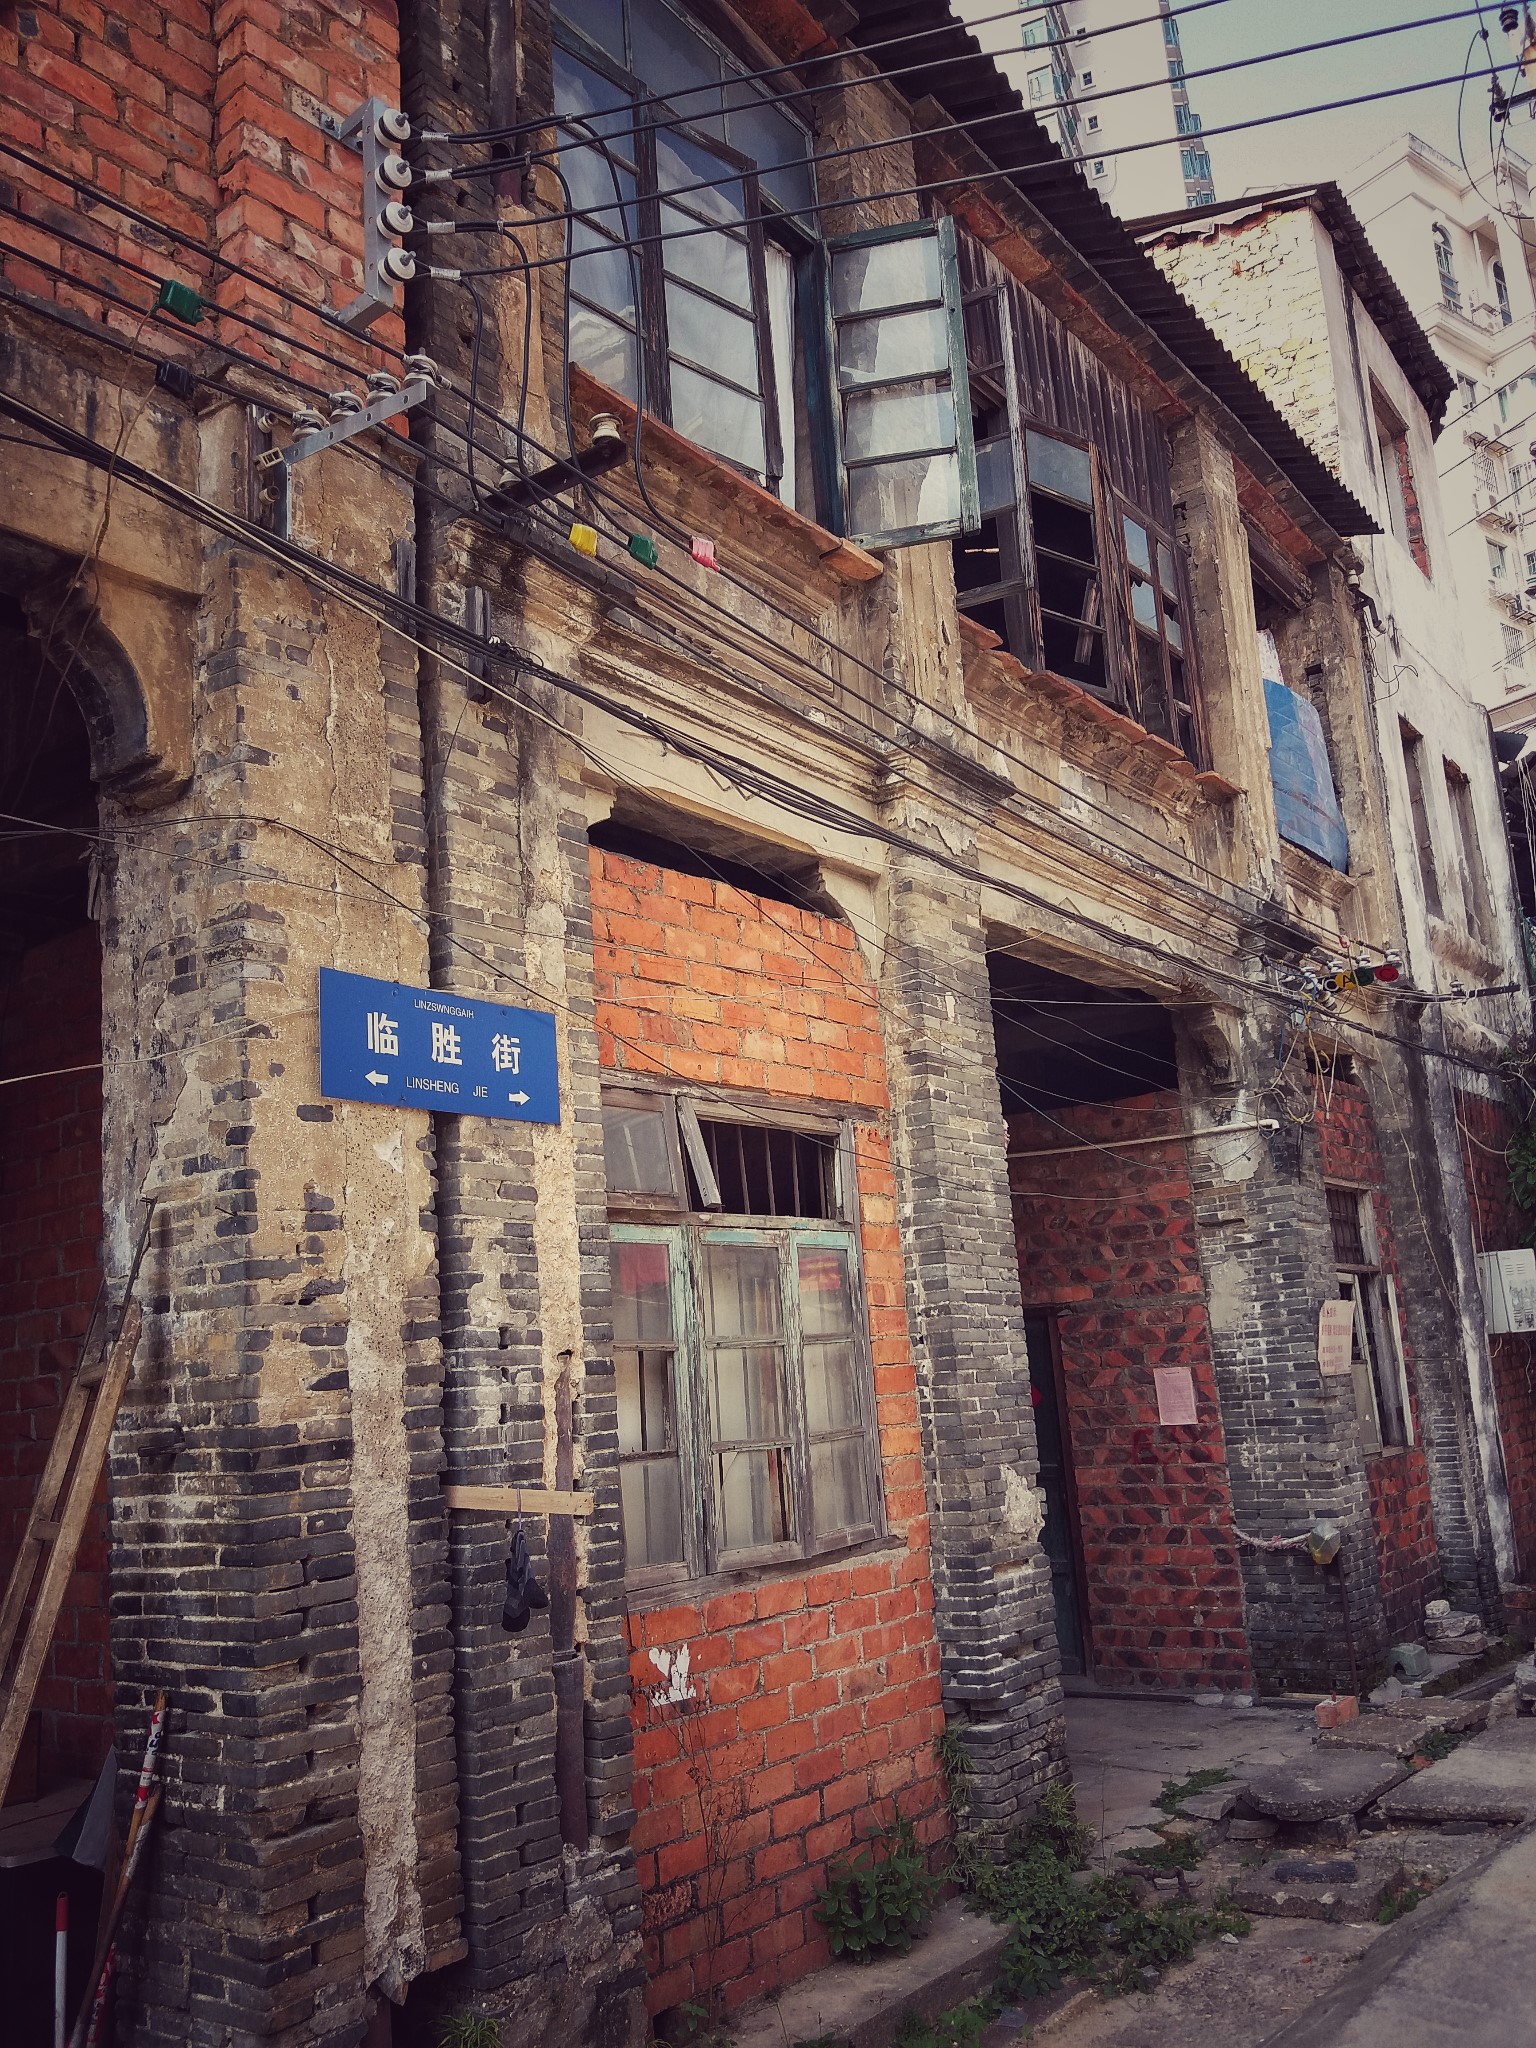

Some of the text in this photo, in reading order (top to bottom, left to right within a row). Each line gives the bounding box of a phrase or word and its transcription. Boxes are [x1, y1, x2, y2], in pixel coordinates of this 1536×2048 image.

[414, 999, 475, 1019] LINZSWNGGAIH
[367, 1011, 521, 1075] 临胜街
[406, 1076, 489, 1098] LINSHENG JIE
